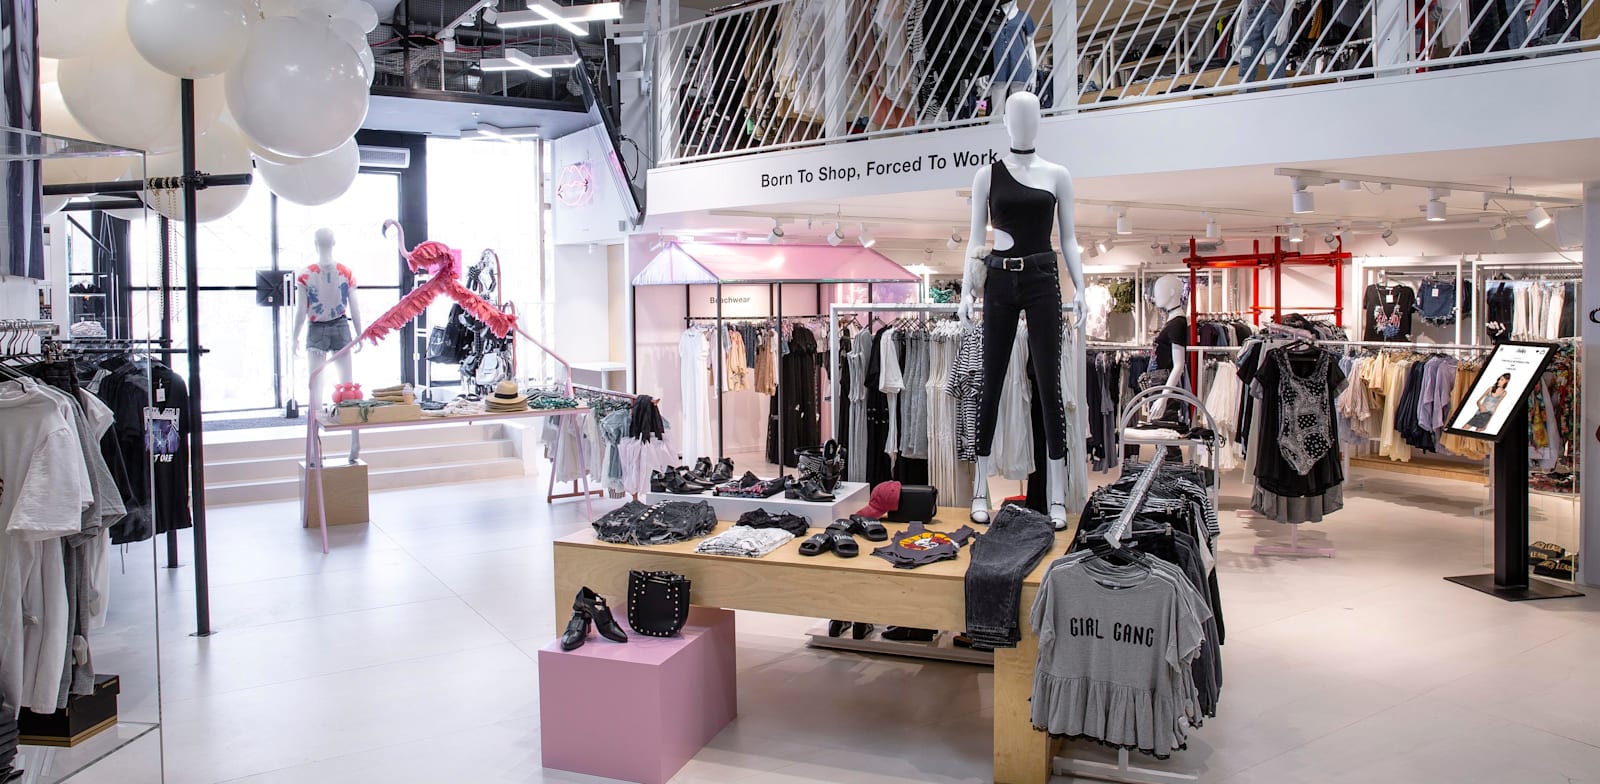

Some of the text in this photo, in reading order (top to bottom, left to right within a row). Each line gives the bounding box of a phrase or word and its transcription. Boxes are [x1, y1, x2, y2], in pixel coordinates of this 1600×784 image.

[761, 148, 998, 188] Born To Shop, Forced To Work
[1070, 617, 1154, 648] GIRL GANG
